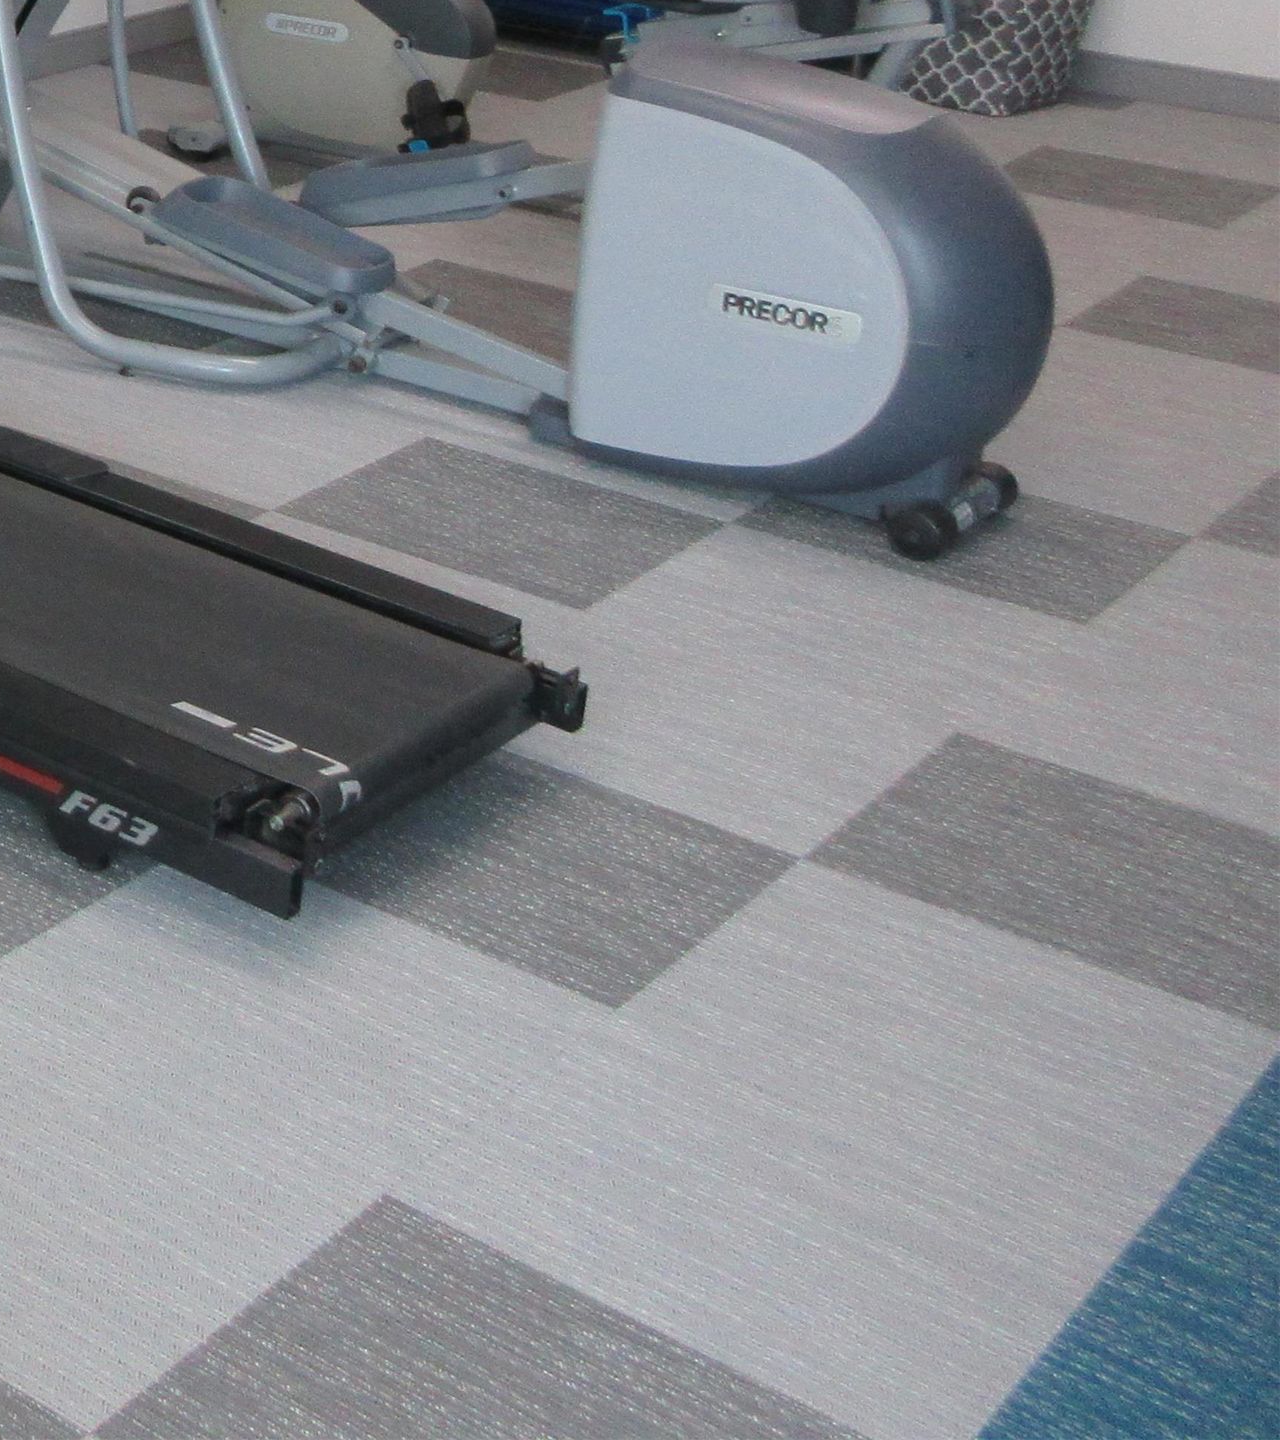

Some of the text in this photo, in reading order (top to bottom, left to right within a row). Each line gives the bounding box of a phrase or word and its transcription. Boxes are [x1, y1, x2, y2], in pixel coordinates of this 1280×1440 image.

[286, 19, 337, 38] PRECOR
[722, 291, 828, 335] PRECOR
[58, 789, 160, 846] F63
